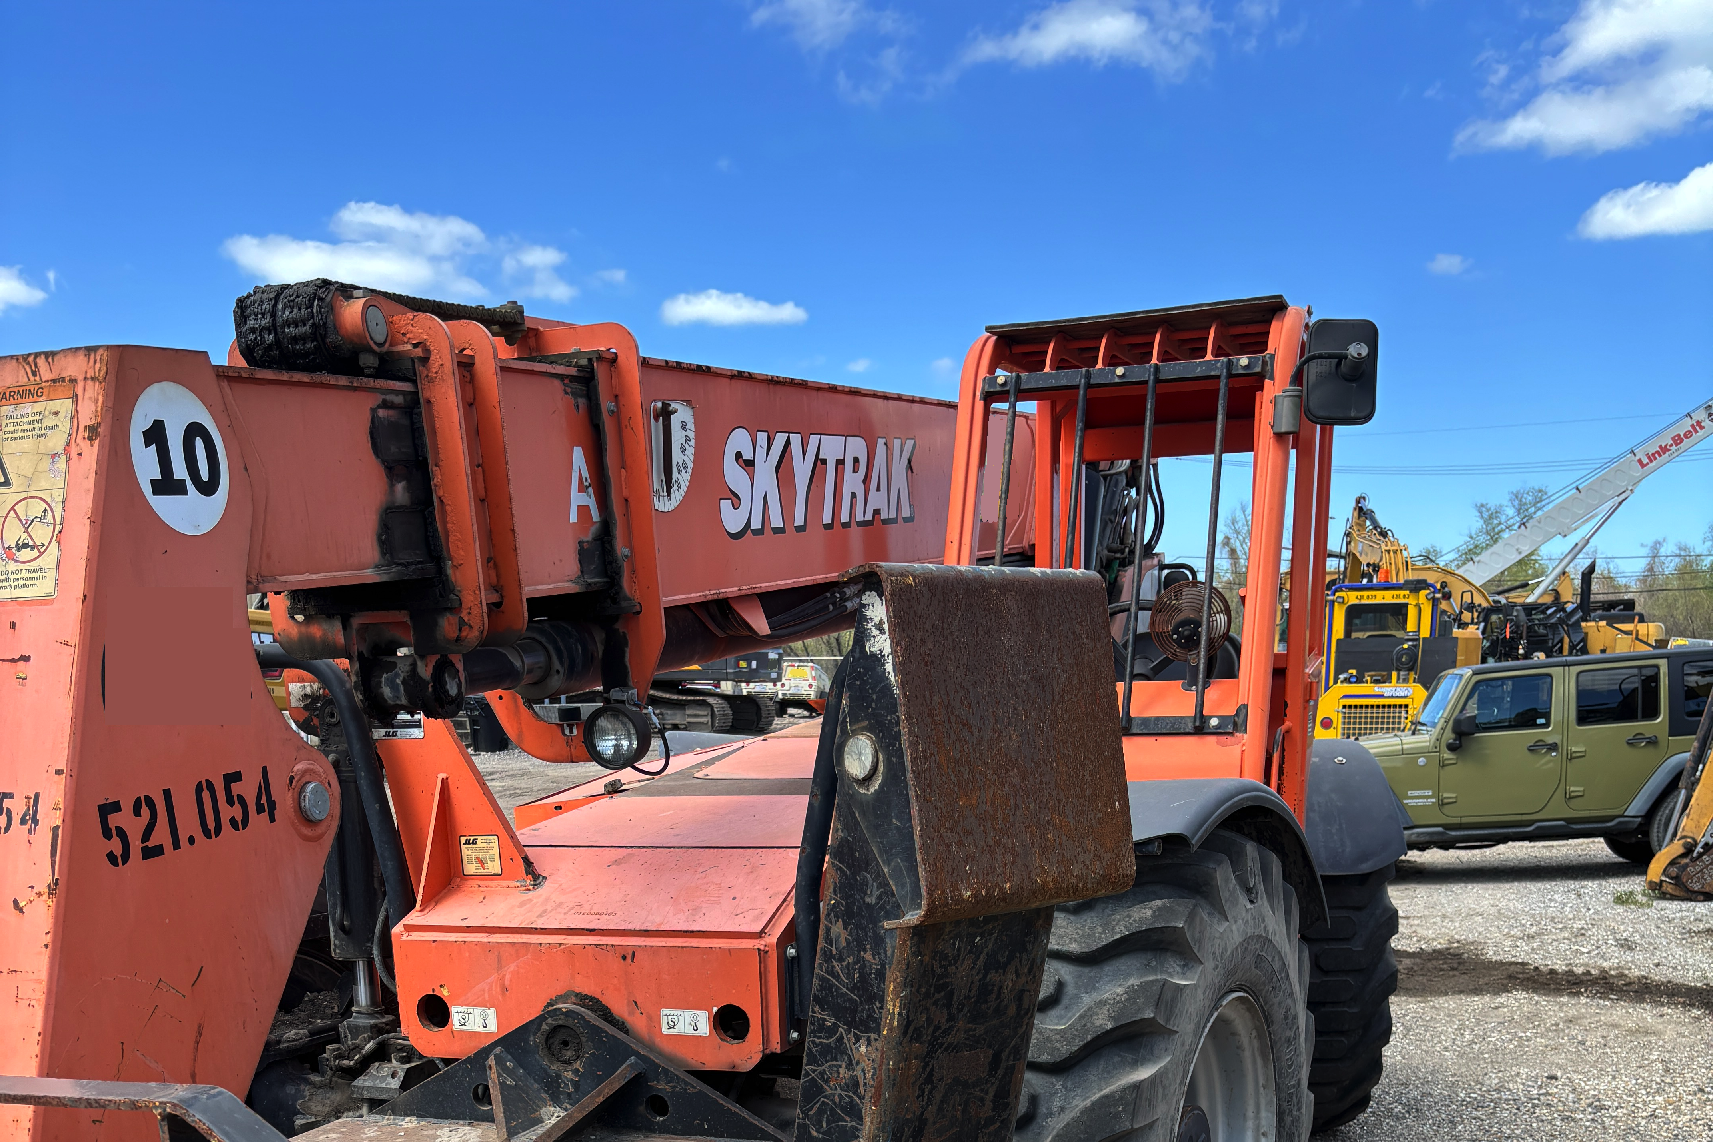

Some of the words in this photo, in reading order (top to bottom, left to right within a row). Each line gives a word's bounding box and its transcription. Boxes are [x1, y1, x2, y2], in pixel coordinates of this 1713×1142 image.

[0, 387, 44, 402] ARNING
[142, 418, 221, 498] 10
[569, 446, 601, 523] A
[719, 426, 916, 540] SKYTRAK
[97, 765, 277, 868] 521.054
